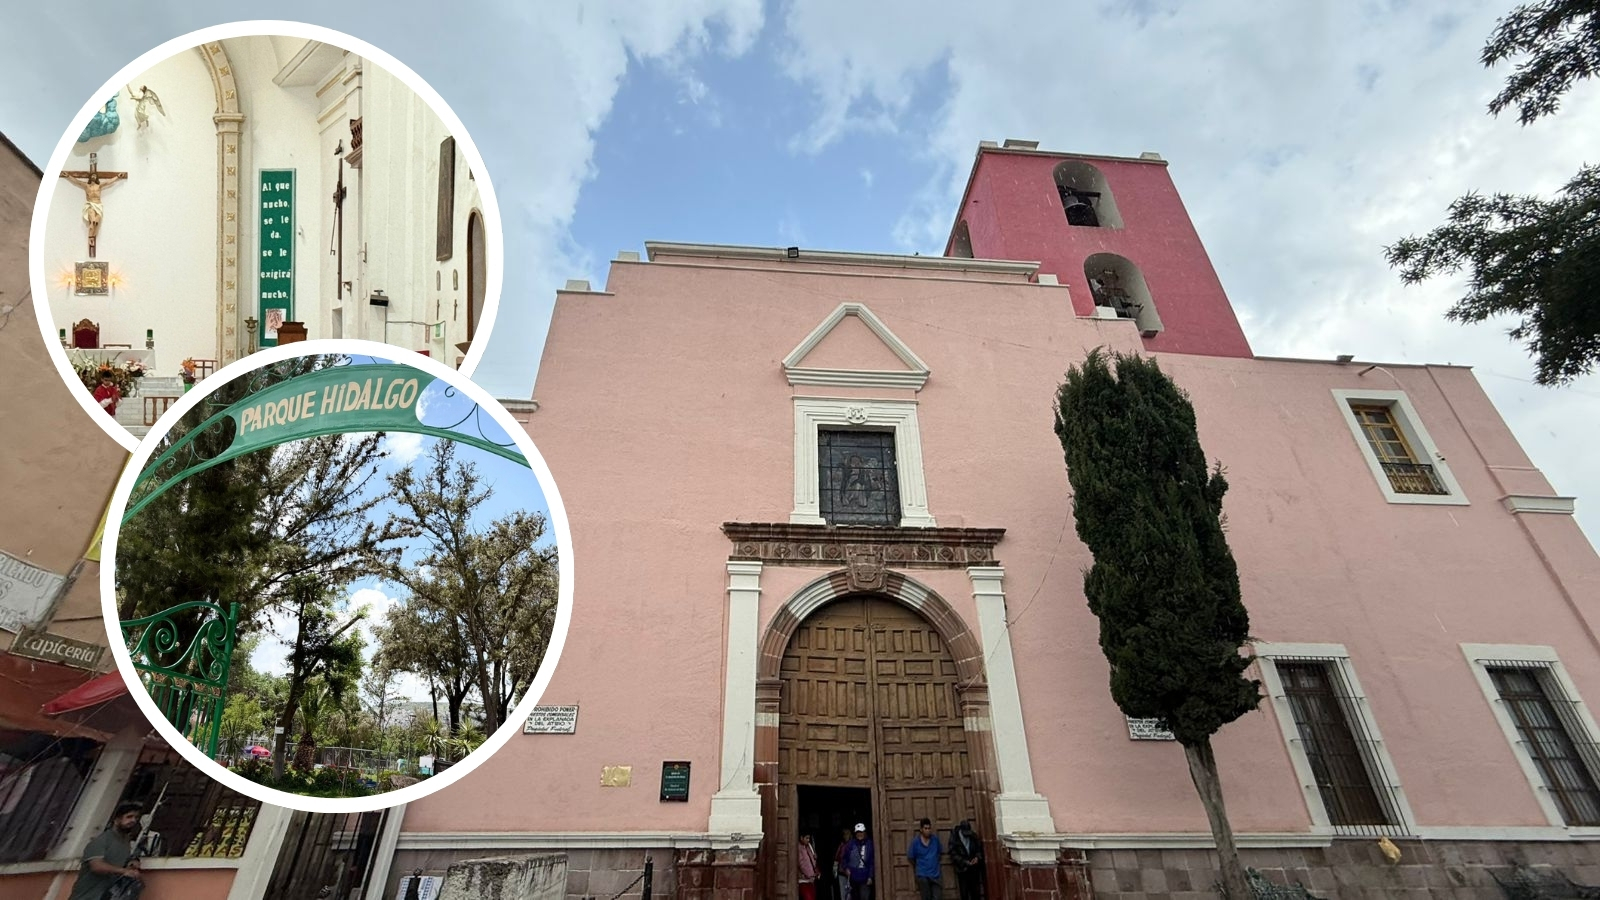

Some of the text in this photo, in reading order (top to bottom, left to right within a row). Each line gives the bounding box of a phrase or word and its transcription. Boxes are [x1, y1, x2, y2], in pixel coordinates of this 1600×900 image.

[262, 182, 290, 192] Al que
[263, 215, 289, 225] se le
[262, 248, 287, 257] se le
[239, 390, 317, 437] PARQUE
